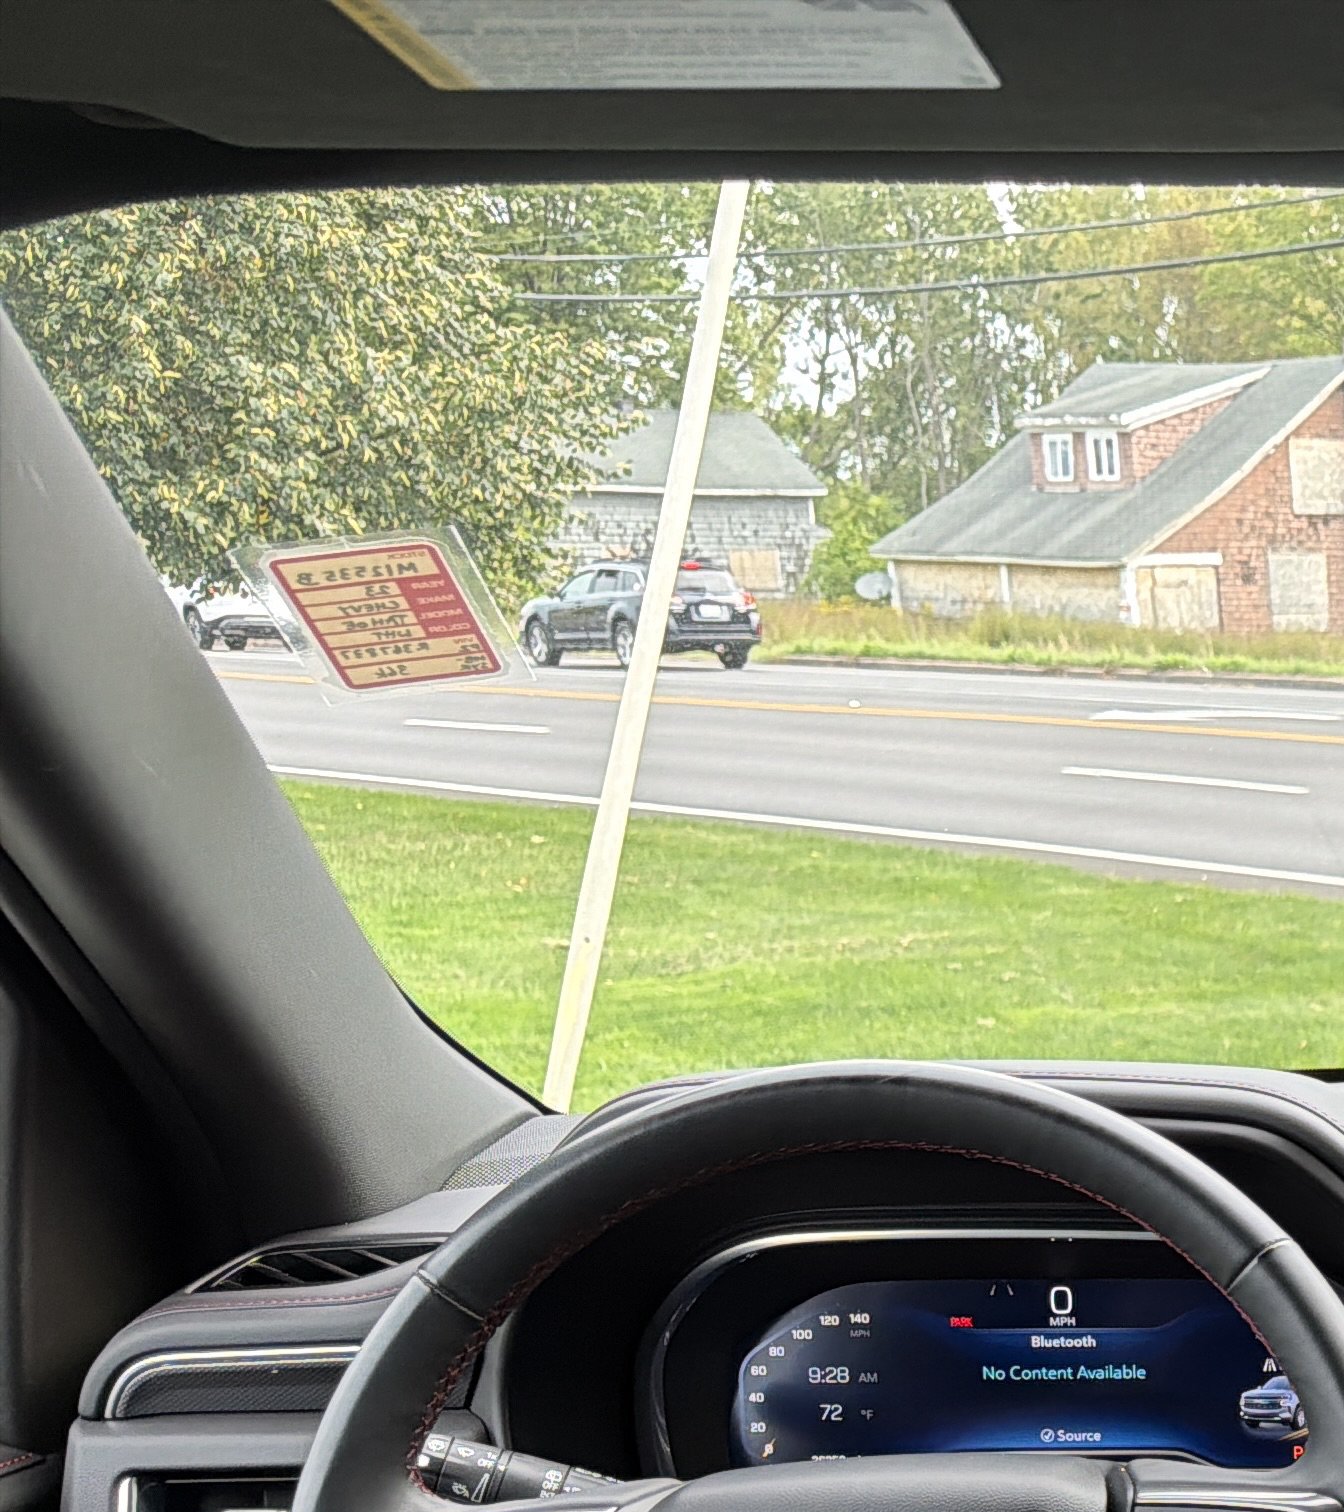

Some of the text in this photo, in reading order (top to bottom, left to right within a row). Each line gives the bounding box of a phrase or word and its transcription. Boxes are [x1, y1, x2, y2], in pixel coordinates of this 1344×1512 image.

[1050, 1286, 1073, 1315] 0
[819, 1315, 840, 1326] 120
[849, 1313, 870, 1324] 140
[1049, 1316, 1076, 1327] MPH
[791, 1329, 813, 1340] 100
[850, 1329, 871, 1338] MPH
[1030, 1335, 1097, 1348] Bluetooth
[769, 1346, 785, 1357] 80
[751, 1365, 767, 1376] 60
[808, 1367, 879, 1384] 9:28 AM
[982, 1364, 1147, 1380] No Content Available
[749, 1392, 765, 1403] 40
[819, 1404, 844, 1421] 72
[750, 1422, 766, 1433] 20
[1057, 1430, 1102, 1441] Source
[1293, 1446, 1304, 1459] P
